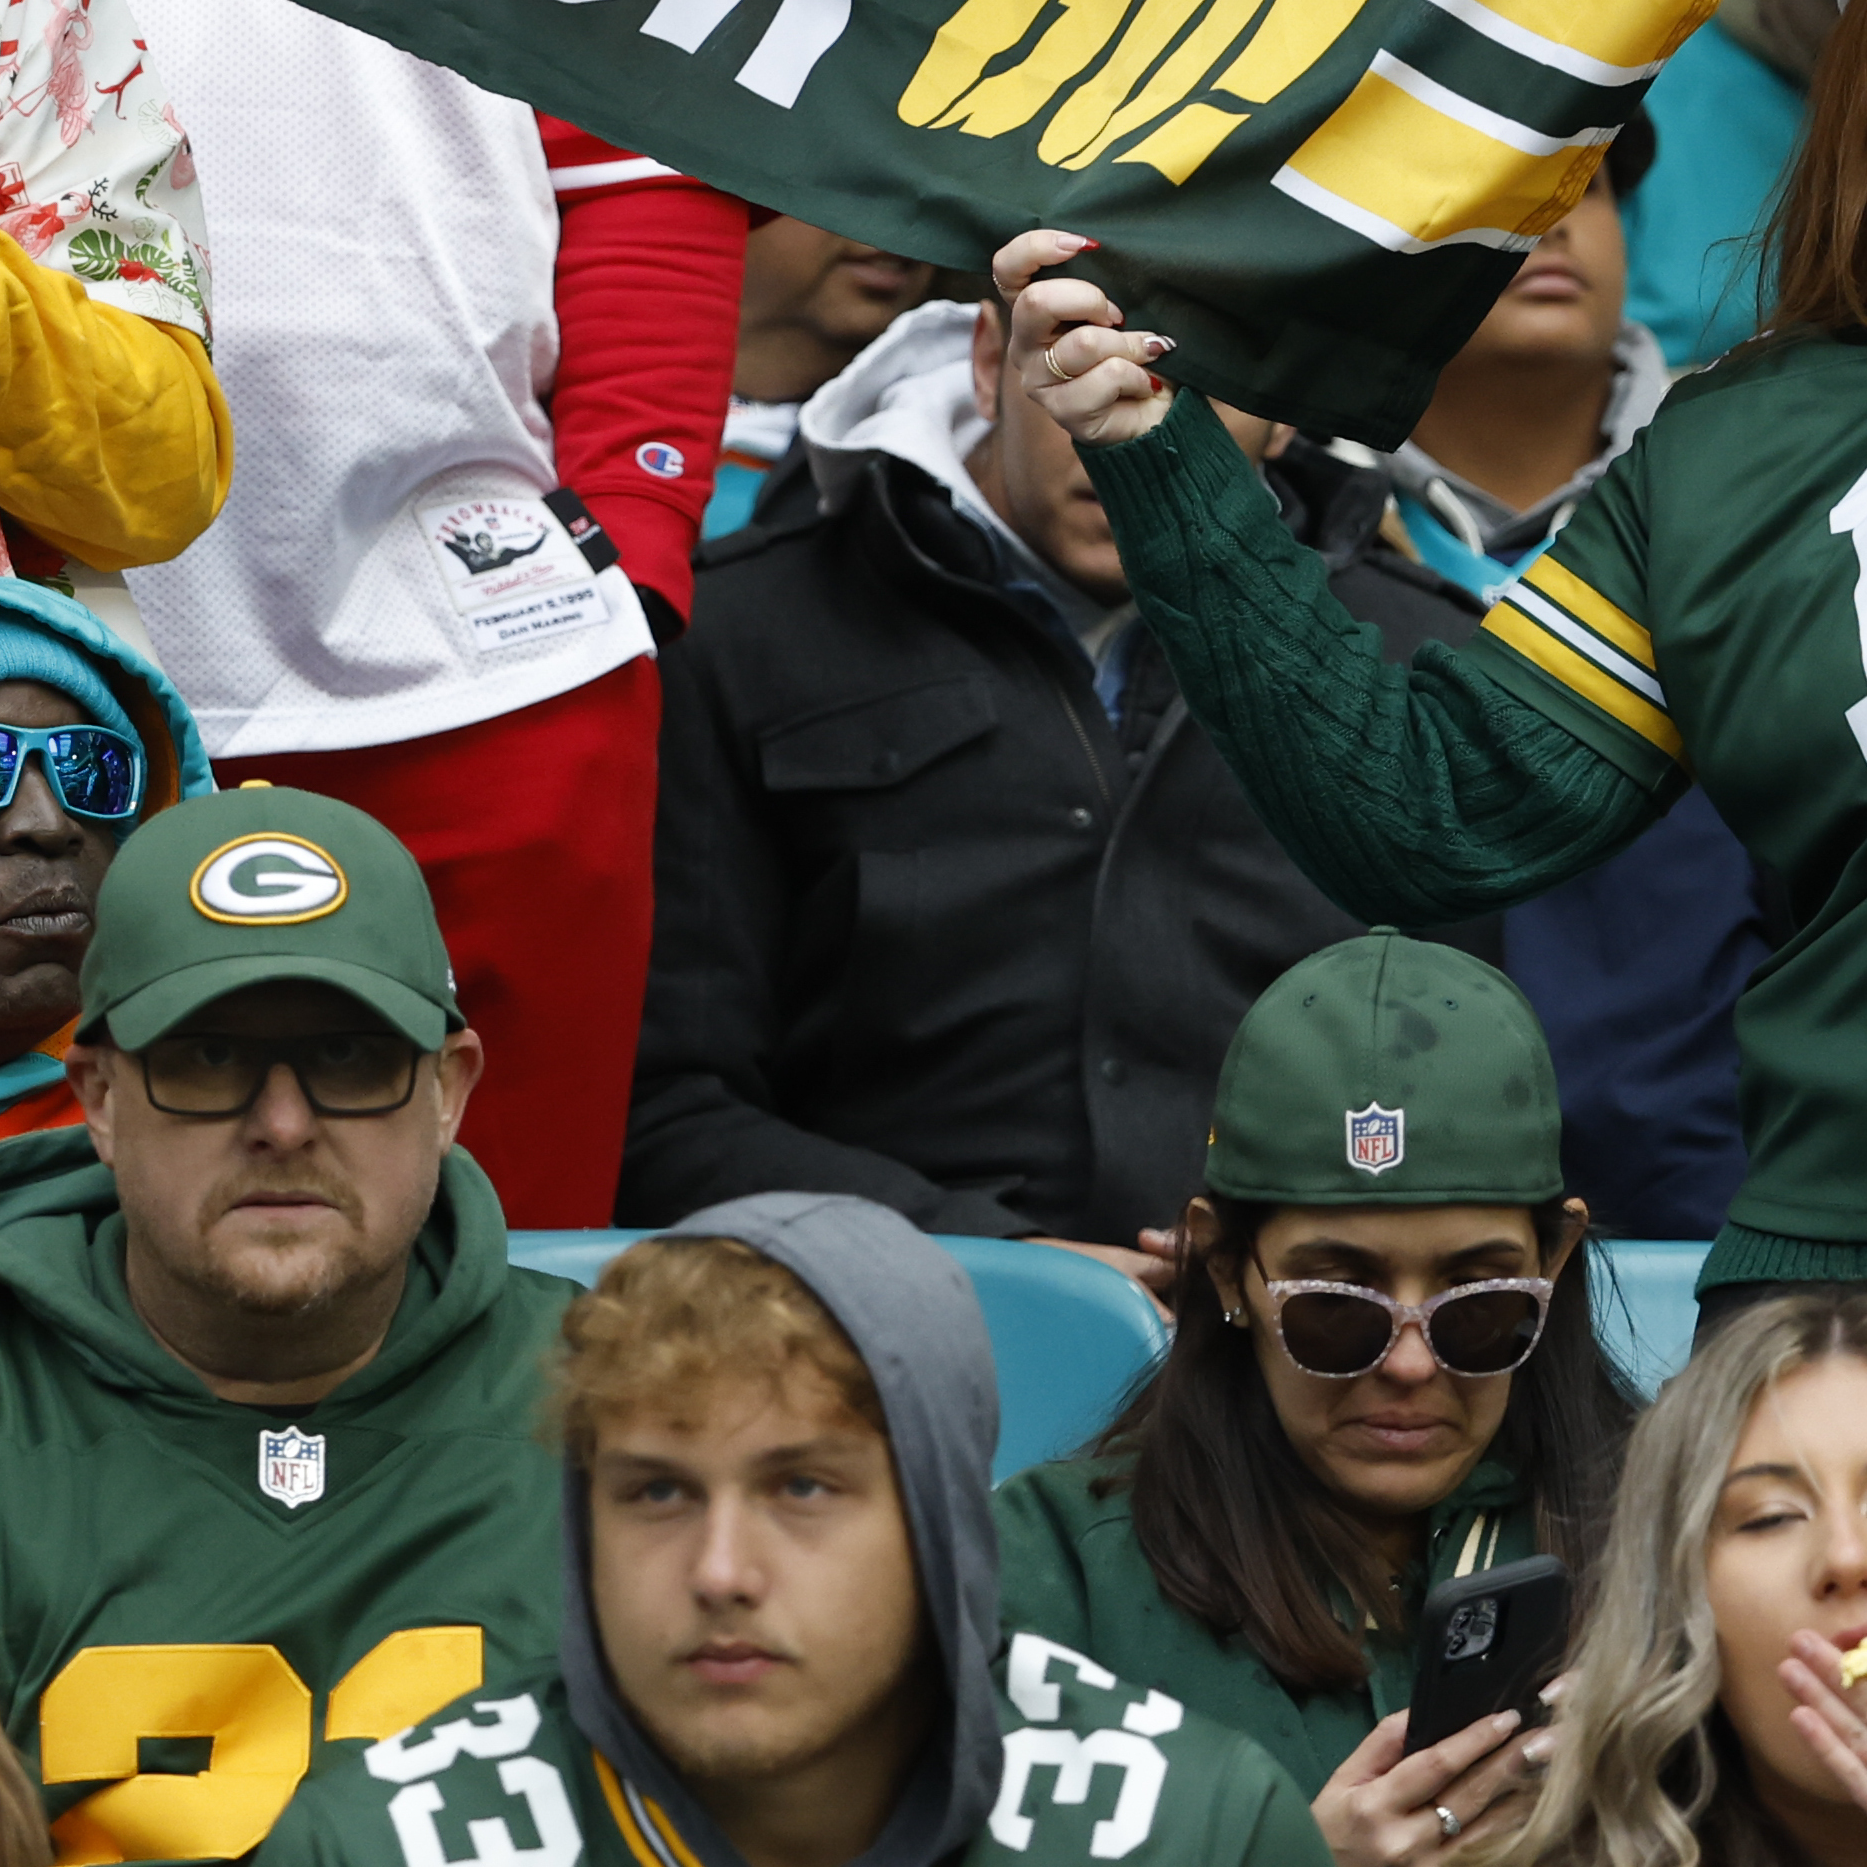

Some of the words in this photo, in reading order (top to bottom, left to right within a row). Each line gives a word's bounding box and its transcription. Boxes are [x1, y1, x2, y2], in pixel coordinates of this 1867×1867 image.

[199, 839, 340, 915] G
[1356, 1136, 1393, 1162] NFL
[270, 1460, 314, 1491] NFL
